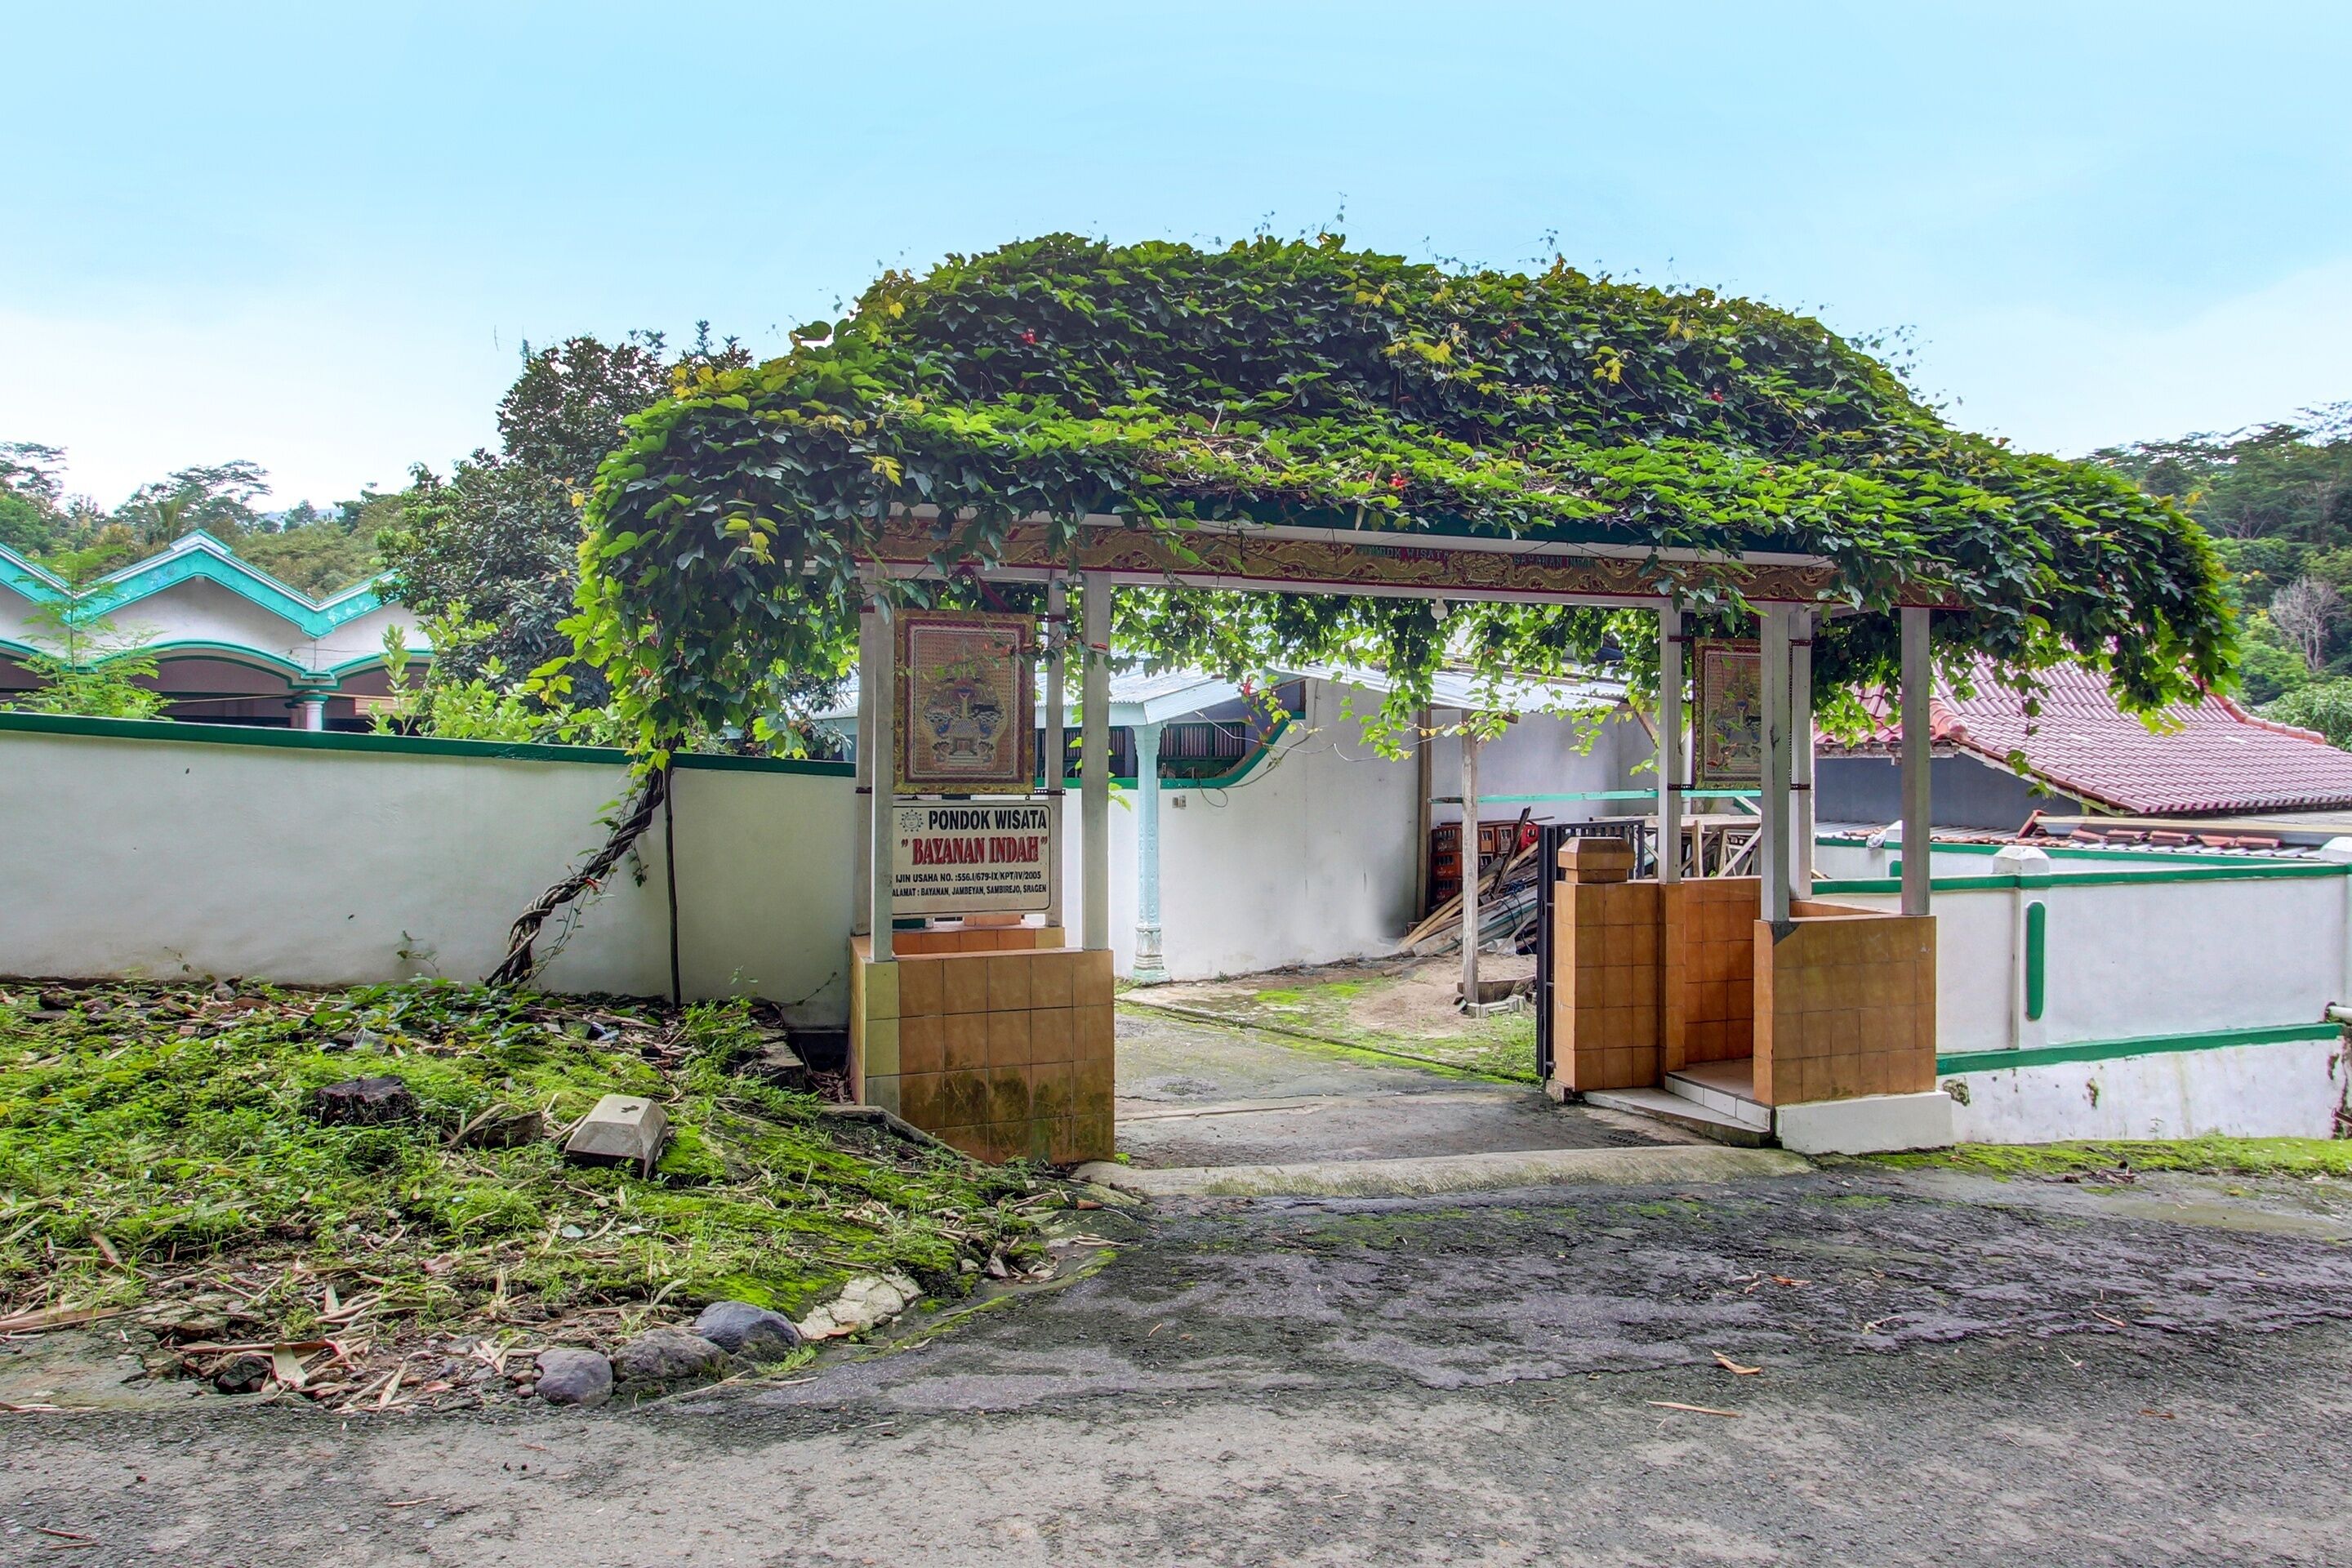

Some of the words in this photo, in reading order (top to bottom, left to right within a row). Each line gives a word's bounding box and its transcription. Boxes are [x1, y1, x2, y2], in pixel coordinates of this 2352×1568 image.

[929, 810, 991, 830] PONDOK
[995, 809, 1047, 830] WISATA
[896, 875, 911, 883] IJIN
[913, 874, 938, 882] USAHA
[940, 873, 953, 881] NO.
[892, 888, 916, 897] ALAMAT
[920, 887, 951, 897] BAYANAN,
[951, 886, 986, 895] JAMBEYAN,
[987, 884, 1022, 894] SAMBIREJO,
[1023, 884, 1047, 893] SRAGEN
